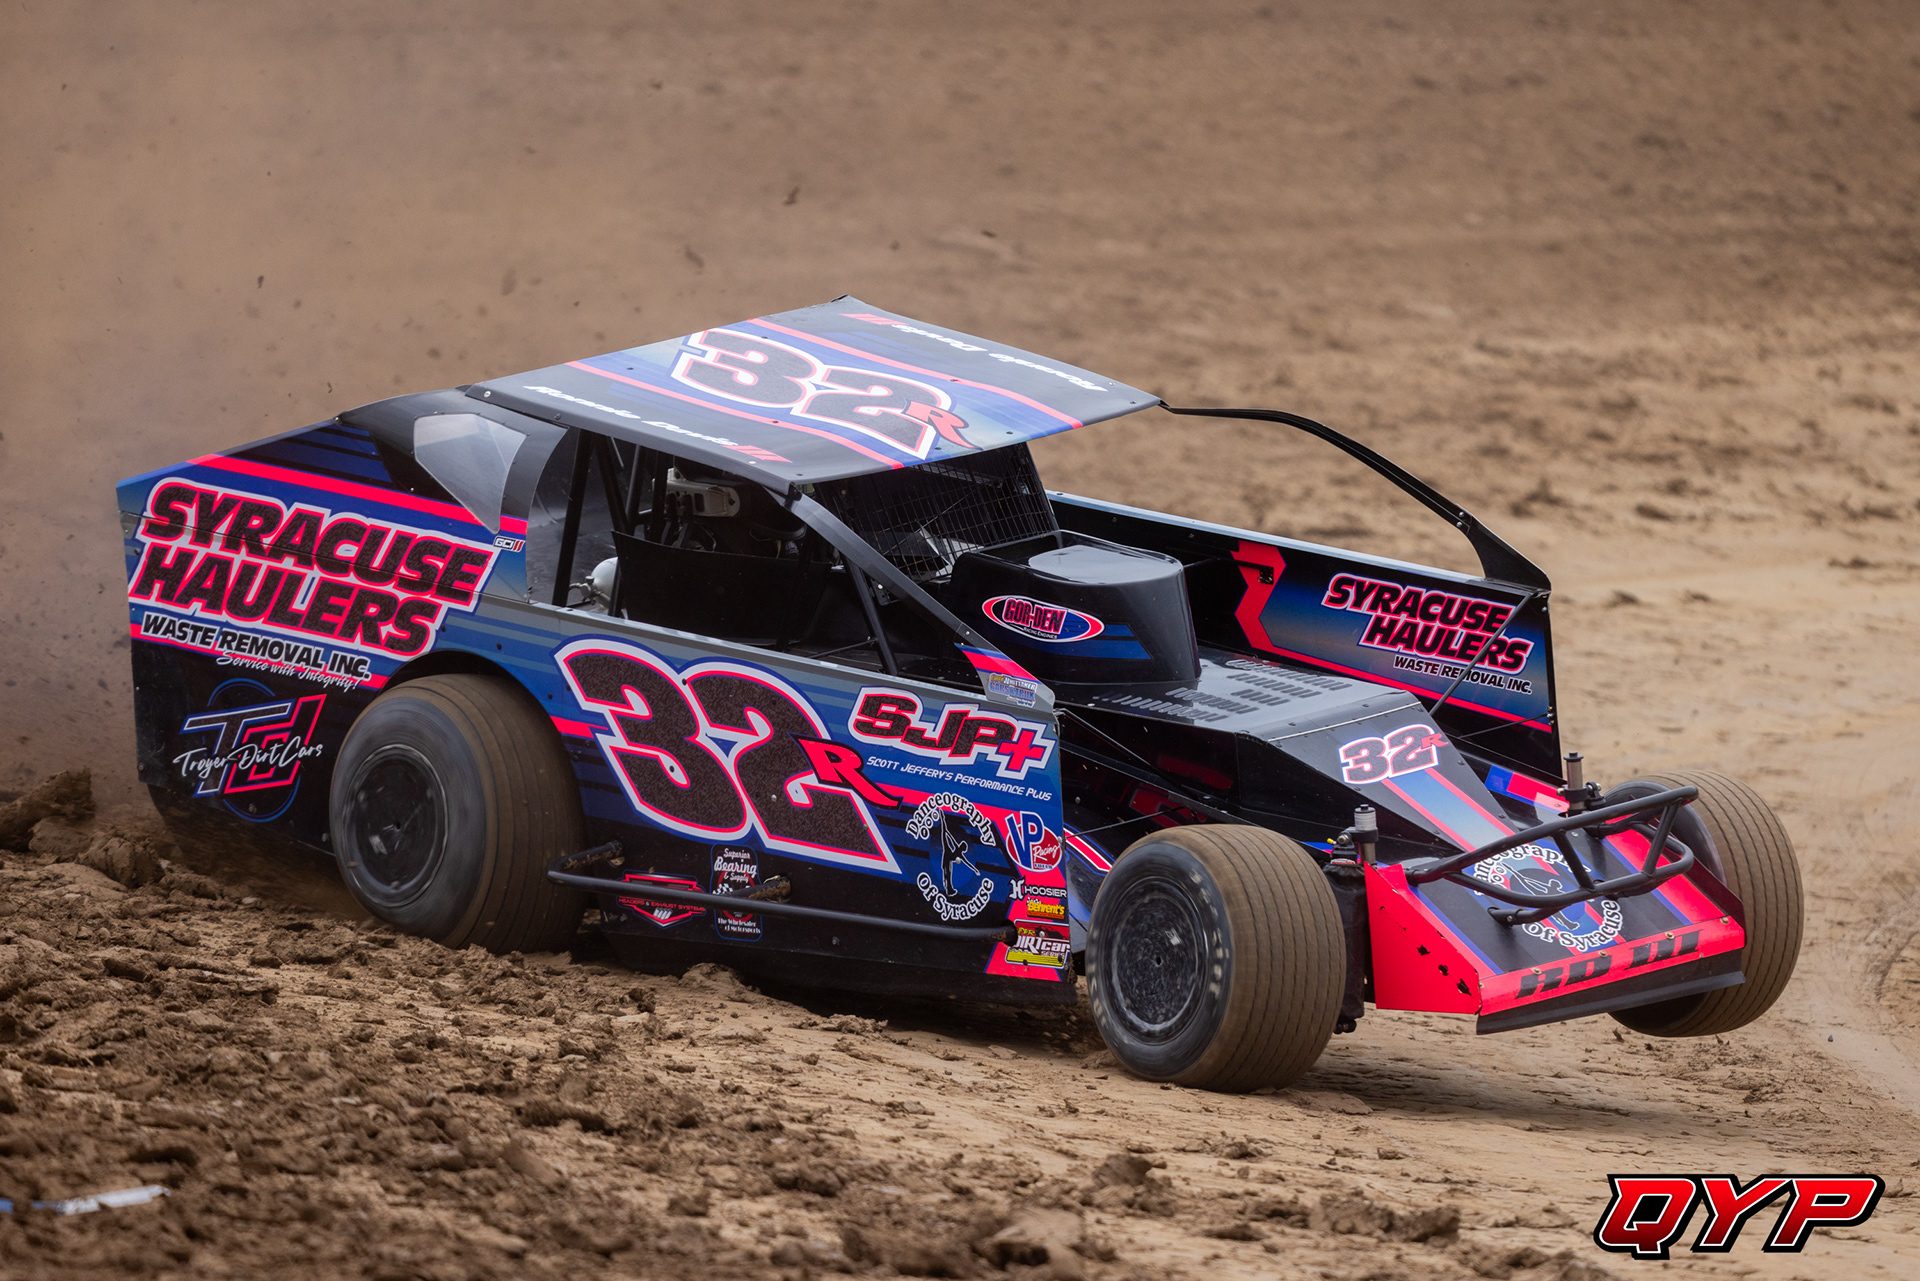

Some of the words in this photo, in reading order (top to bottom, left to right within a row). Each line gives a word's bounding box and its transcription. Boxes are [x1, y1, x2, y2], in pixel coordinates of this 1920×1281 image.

[141, 480, 496, 608] SYRACUSE
[129, 542, 443, 657] HAULERS
[1002, 598, 1067, 634] GOR-DEN
[1322, 573, 1516, 635] SYRACUSE
[141, 612, 220, 648] WASTE
[216, 629, 324, 669] REMOVAL
[327, 651, 372, 681] INC.
[1358, 614, 1534, 674] HAULERS
[216, 651, 271, 672] Service
[270, 661, 296, 677] with
[298, 668, 364, 693] Integrity!
[1394, 655, 1440, 675] WASTE
[1440, 665, 1506, 689] REMOVAL
[1506, 677, 1533, 695] INC.
[172, 747, 230, 779] Troyer
[228, 743, 284, 770] Dirt
[278, 736, 324, 768] Cars
[867, 755, 900, 771] SCOTT
[901, 763, 954, 781] JEFFERY'S
[954, 772, 1026, 796] PERFORMANCE
[1026, 789, 1053, 801] PLUS
[905, 791, 997, 847] Danceography
[1005, 810, 1044, 870] VP
[713, 856, 757, 879] Bearing
[724, 871, 730, 880] &
[1033, 843, 1061, 863] Racing
[1474, 842, 1592, 895] anceograp
[917, 872, 939, 902] Of
[932, 877, 995, 921] Syracuse
[1024, 885, 1068, 898] HOOSIER
[1027, 900, 1066, 915] Behrent's
[1521, 921, 1558, 943] Of
[1557, 899, 1623, 951] Syracuse
